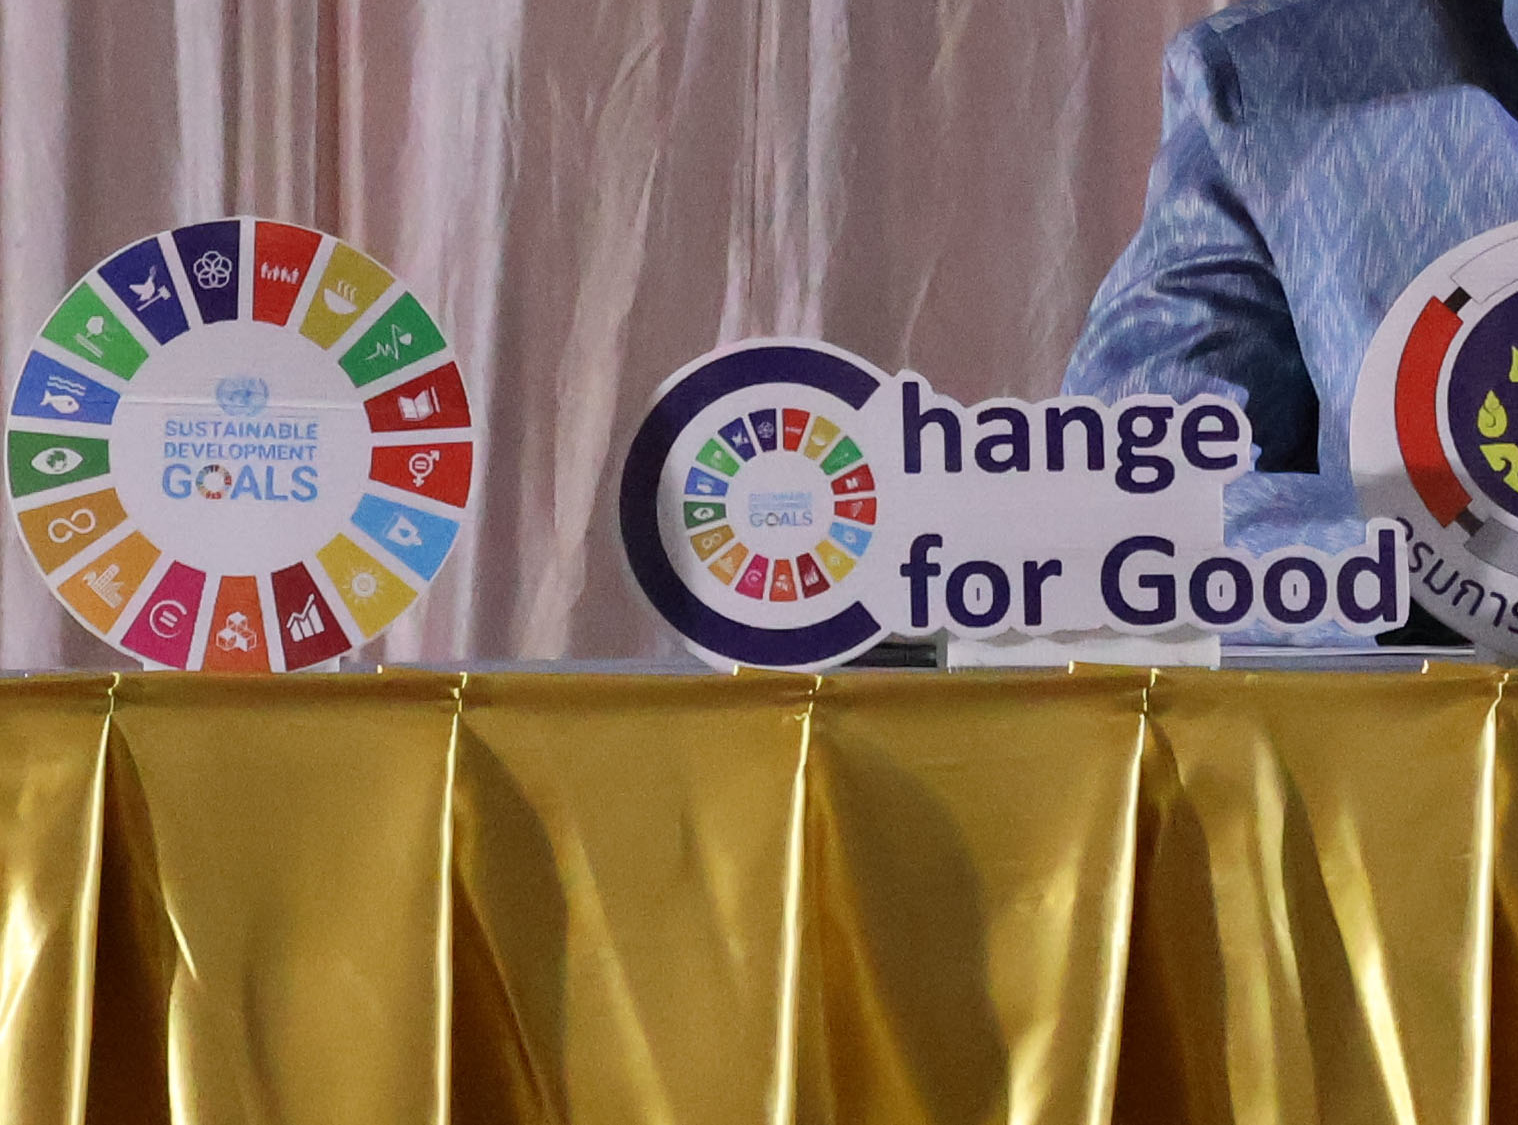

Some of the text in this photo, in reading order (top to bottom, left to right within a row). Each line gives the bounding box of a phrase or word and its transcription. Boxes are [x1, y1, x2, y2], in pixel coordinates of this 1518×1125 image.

[164, 419, 319, 440] SUSTAINABLE
[164, 441, 318, 461] DEVELOPMENT
[162, 463, 319, 503] GOALS
[899, 528, 1399, 628] for Good
